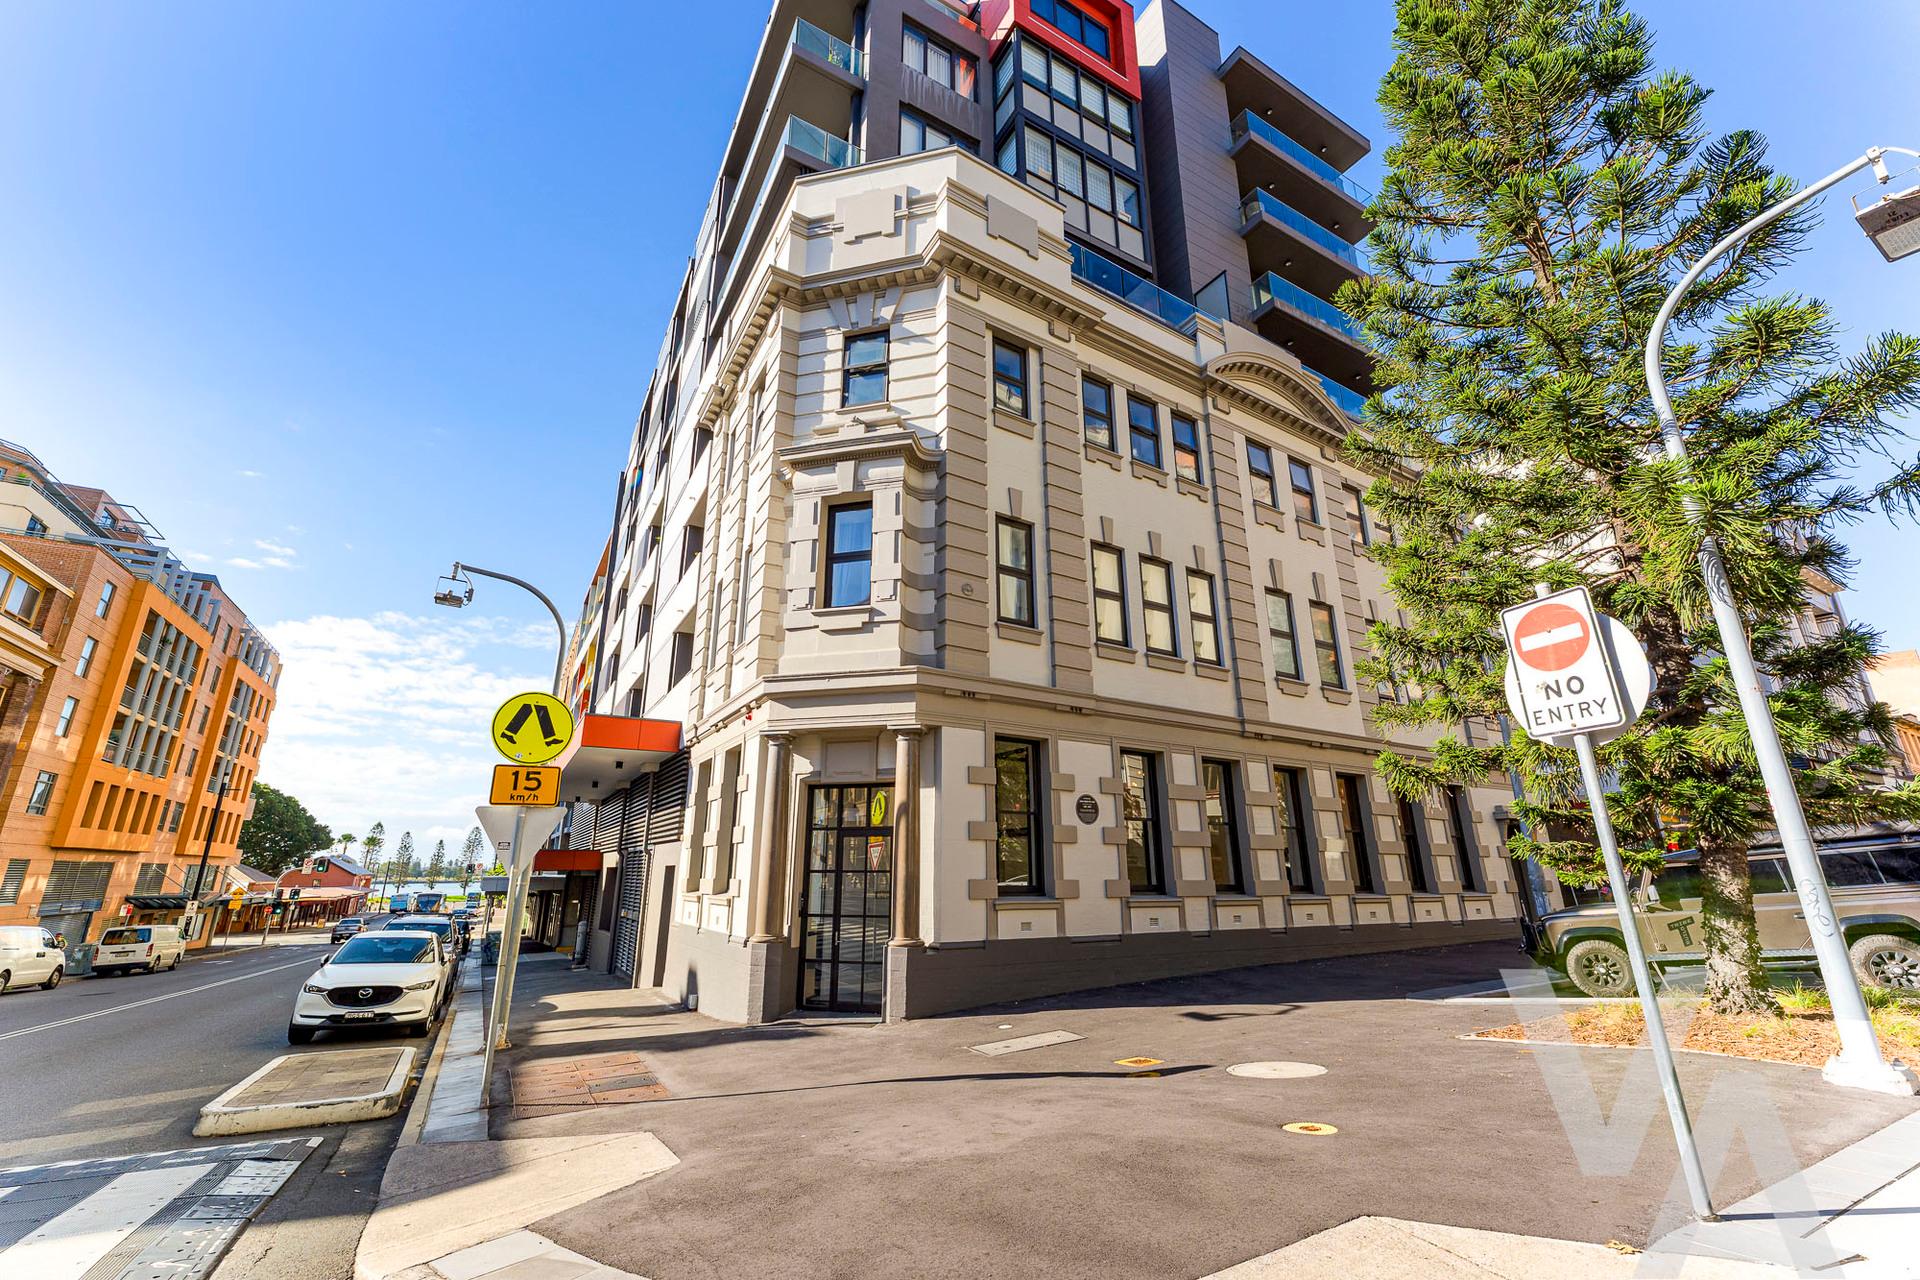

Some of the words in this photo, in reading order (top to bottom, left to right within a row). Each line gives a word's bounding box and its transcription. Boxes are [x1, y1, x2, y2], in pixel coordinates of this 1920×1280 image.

[1544, 676, 1584, 700] NO
[1533, 698, 1607, 726] ENTRY
[512, 771, 541, 791] 15
